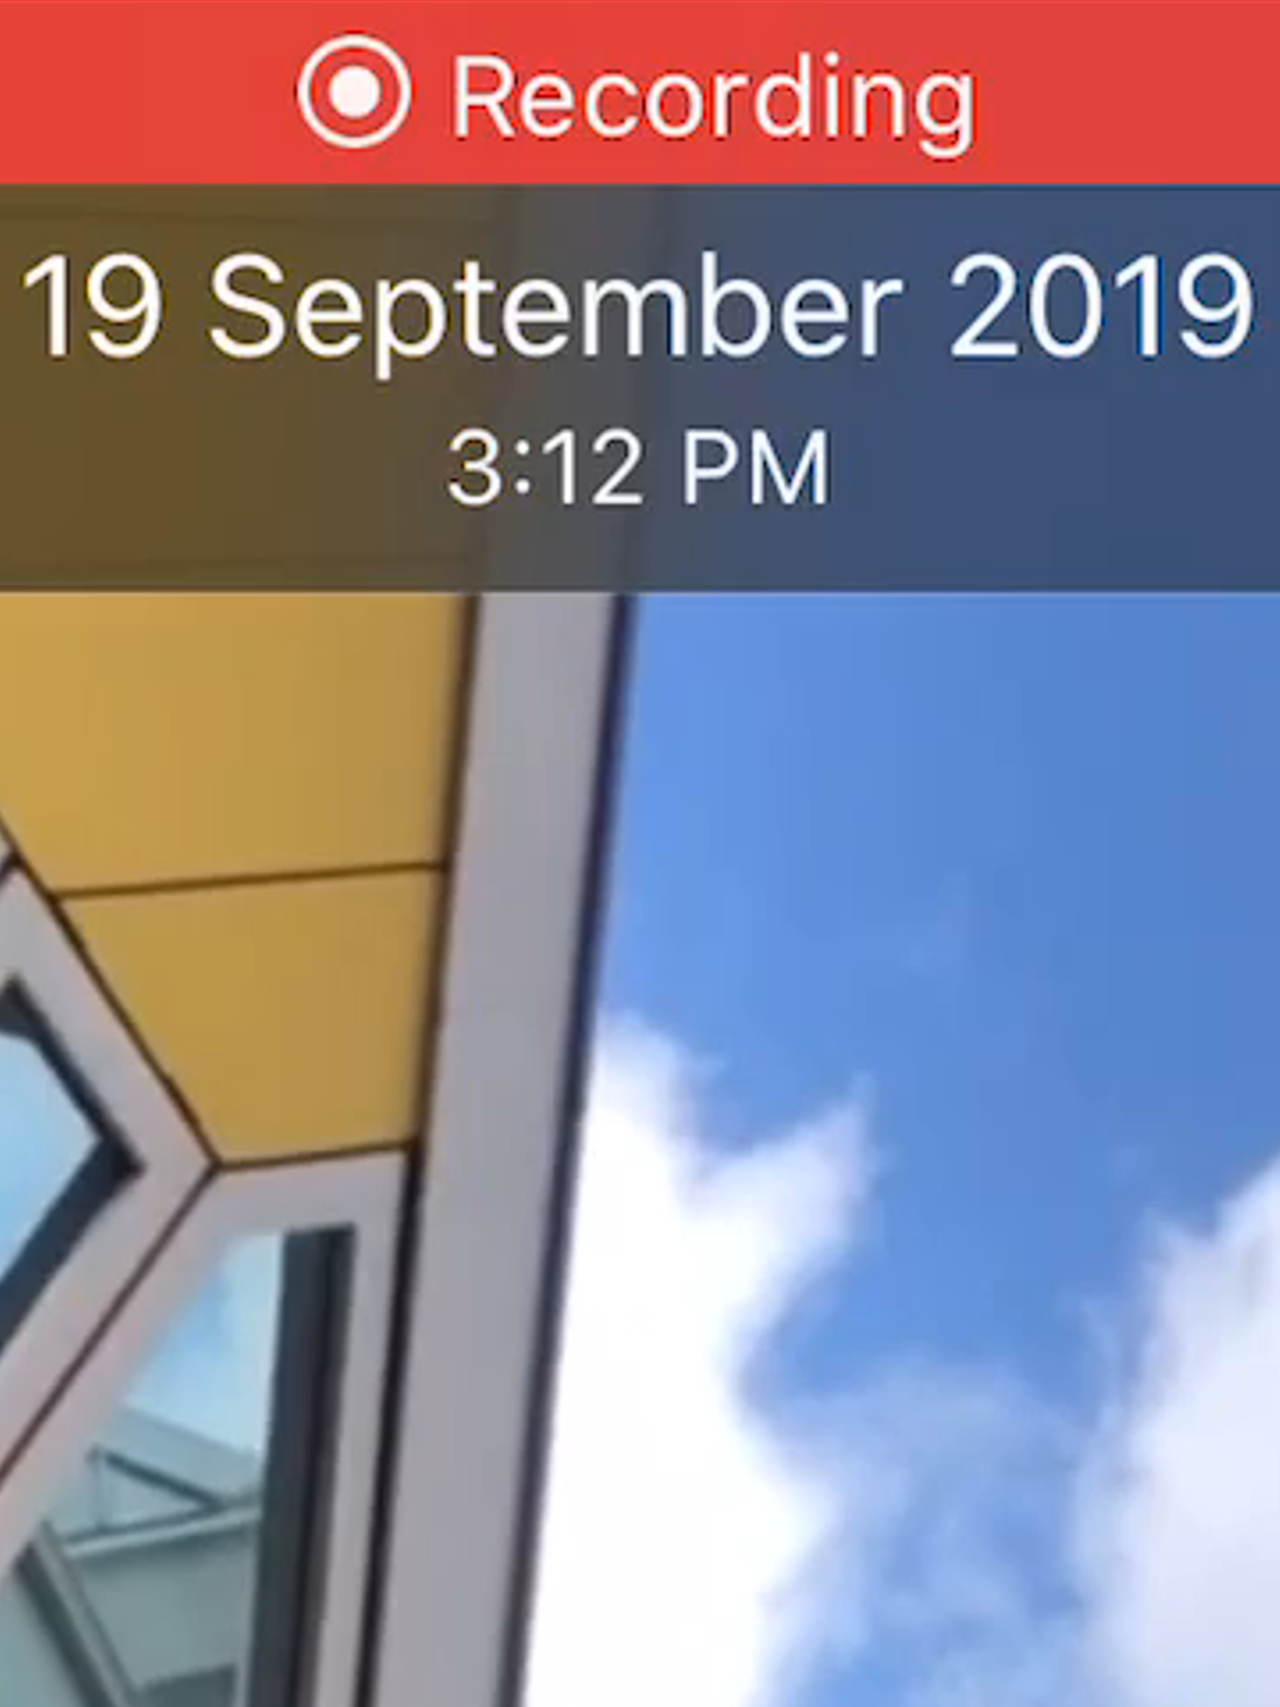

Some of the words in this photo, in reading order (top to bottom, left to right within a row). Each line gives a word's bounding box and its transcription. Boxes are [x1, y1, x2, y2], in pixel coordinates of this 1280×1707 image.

[455, 51, 973, 159] Recording
[25, 252, 162, 359] 19
[210, 250, 904, 382] September
[950, 252, 1253, 359] 2019
[448, 427, 644, 506] 3:12
[684, 428, 827, 506] PM
